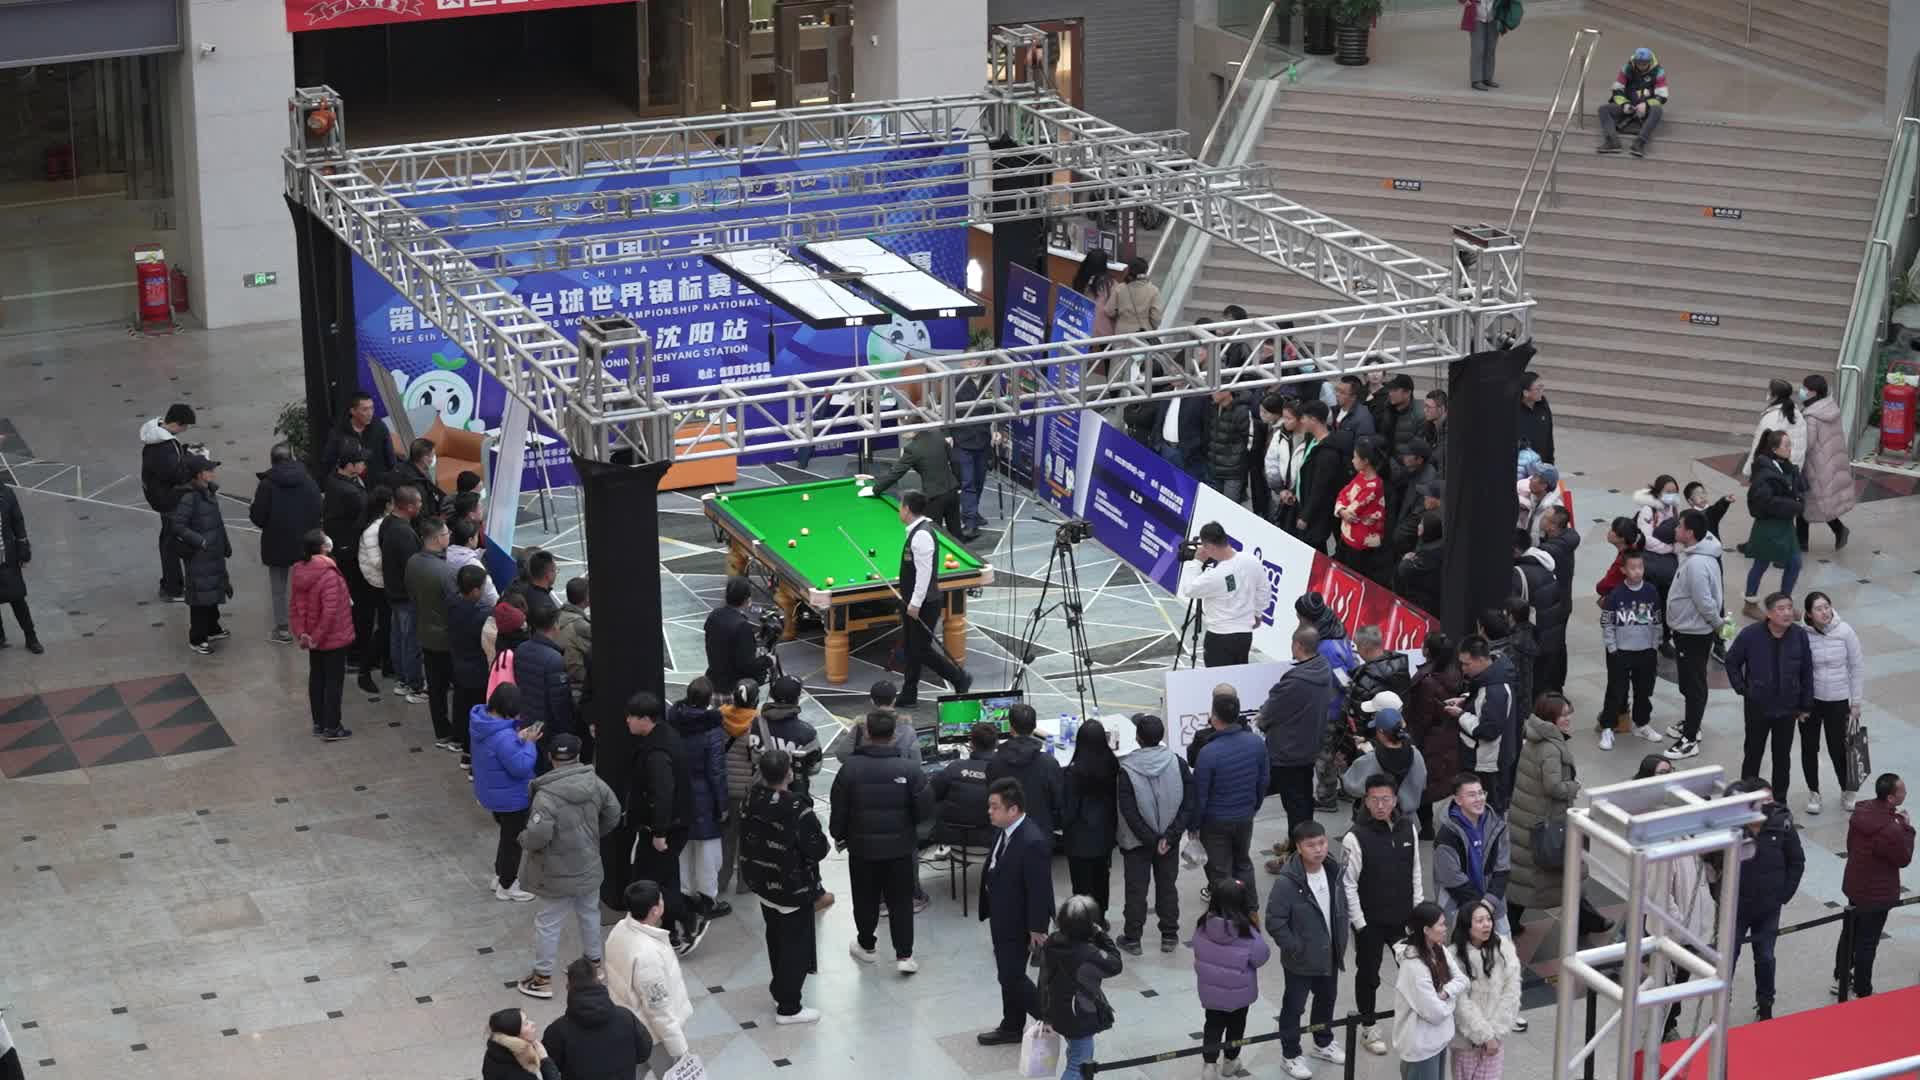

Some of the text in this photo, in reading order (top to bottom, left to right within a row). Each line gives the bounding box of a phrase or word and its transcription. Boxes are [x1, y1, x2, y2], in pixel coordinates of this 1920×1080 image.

[582, 265, 648, 280] CHINA
[391, 334, 413, 345] THE
[417, 333, 436, 342] 6th
[612, 305, 699, 321] AMPIONSHIP
[703, 296, 761, 312] NATIONAL
[654, 317, 749, 350] 沈阳站
[641, 348, 700, 365] HENYANG
[703, 344, 749, 358] STATION
[675, 1058, 695, 1076] OKAY
